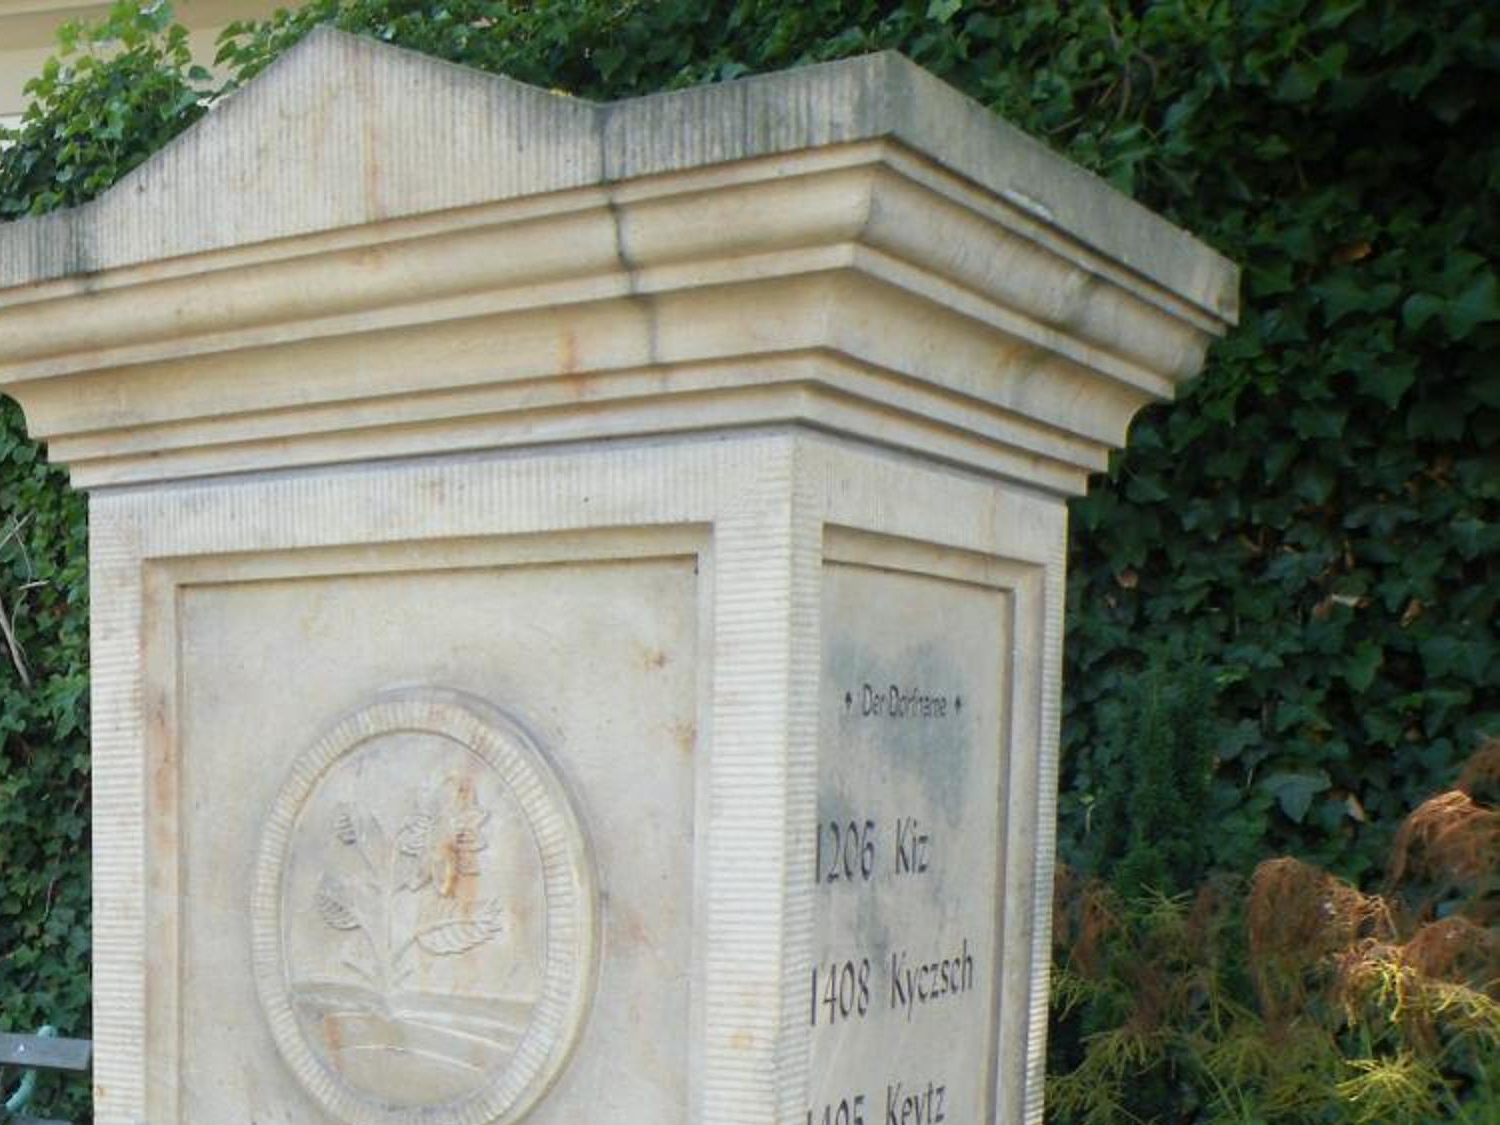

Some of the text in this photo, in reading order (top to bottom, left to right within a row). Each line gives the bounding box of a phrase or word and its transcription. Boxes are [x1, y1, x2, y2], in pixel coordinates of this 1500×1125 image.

[861, 682, 885, 716] Der
[816, 816, 930, 885] 1206 Kiz
[811, 938, 974, 1027] 1408 Kyczsch
